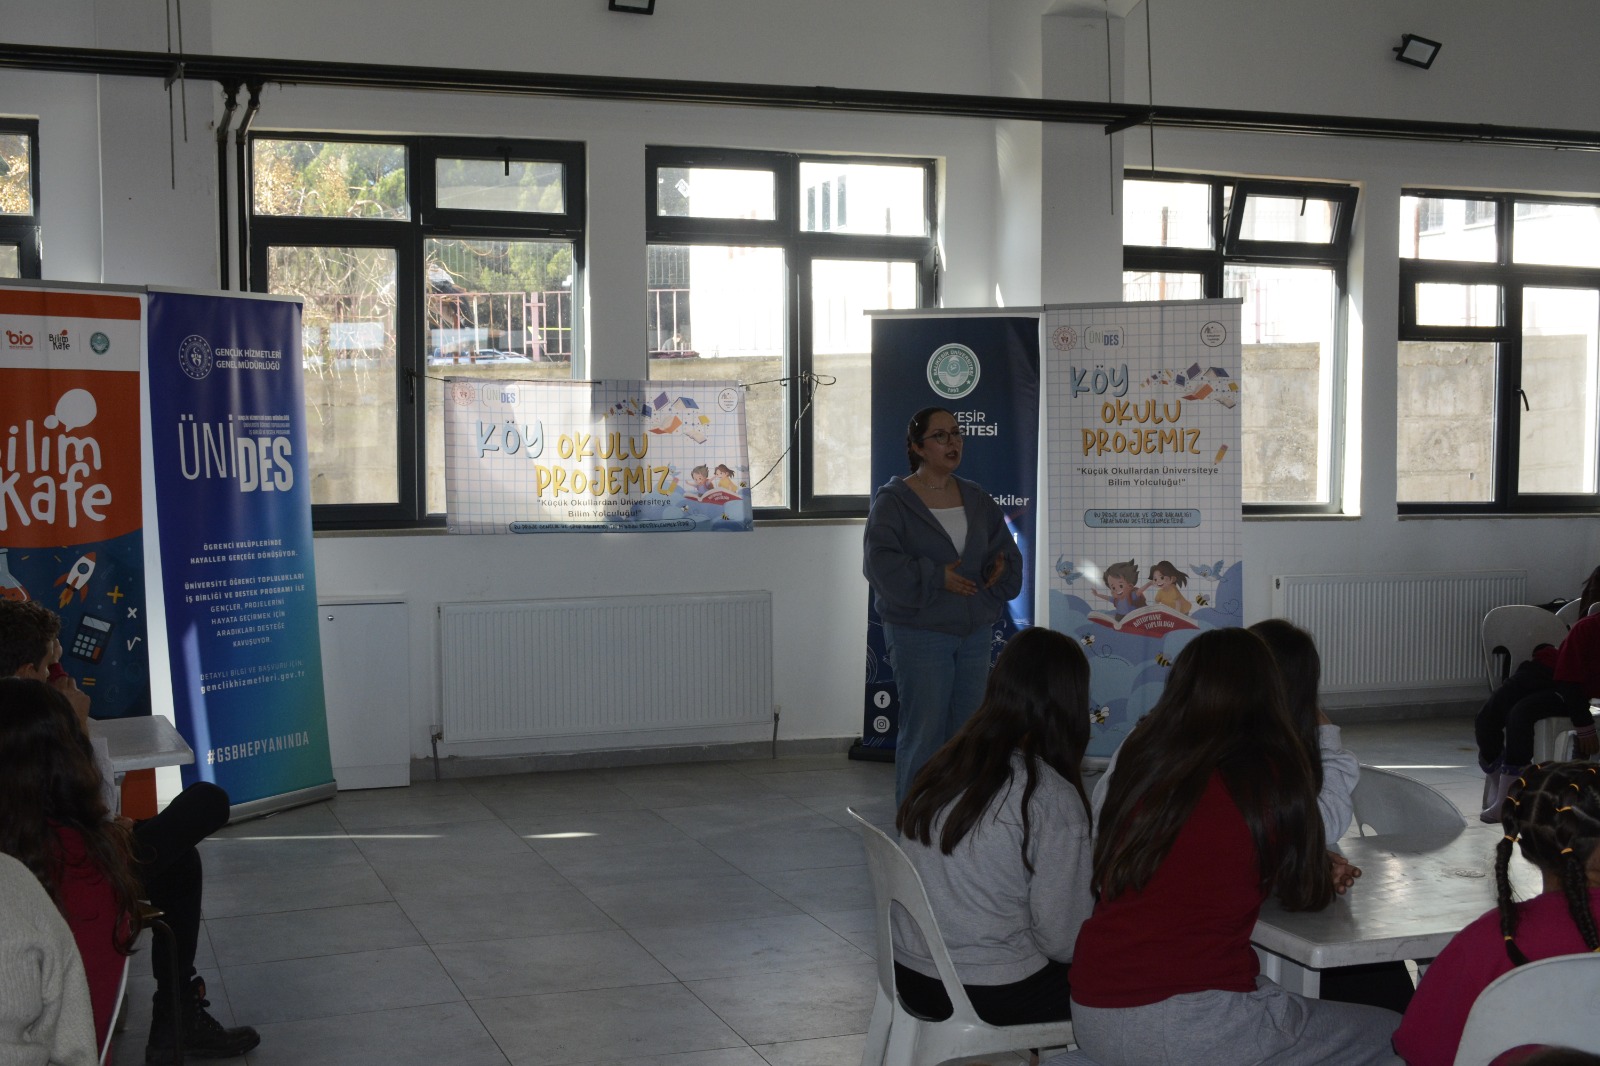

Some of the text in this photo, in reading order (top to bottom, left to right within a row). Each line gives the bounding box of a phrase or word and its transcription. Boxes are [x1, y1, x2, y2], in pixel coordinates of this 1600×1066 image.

[6, 330, 34, 345] bio
[215, 348, 281, 359] GENÇLİK HİZMETLERİ
[216, 360, 280, 371] GENEL MÜDÜRLÜĞÜ
[1070, 363, 1129, 398] KÖY
[953, 409, 986, 423] ESİR
[1101, 399, 1182, 426] OKULU
[0, 414, 102, 475] ilim
[475, 419, 649, 463] KÖY OKULU
[1081, 427, 1201, 457] PROJEMİZ
[1111, 467, 1160, 475] Okullardan
[1162, 466, 1219, 476] Üniversiteye
[534, 464, 670, 498] PROJEMİZ
[1108, 478, 1131, 486] Bilim
[0, 462, 112, 531] Kafe
[570, 499, 618, 507] Okullardan
[620, 498, 671, 507] Üniversiteye
[568, 510, 590, 518] Bilim
[236, 539, 282, 549] KULÜPLERİNDE
[190, 555, 227, 565] HAYALLER
[228, 552, 256, 562] GERÇEĞE
[184, 573, 305, 590] ÜNİVERSİTE ÖĞRENCİ TOPLULUKLARI
[185, 595, 193, 604] İŞ
[195, 591, 222, 602] BİRLİĞİ
[235, 589, 258, 598] DESTEK
[260, 586, 293, 596] PROGRAMI
[211, 616, 238, 625] HAYATA
[239, 612, 271, 622] GEÇİRMEK
[216, 627, 256, 637] ARADIKLARI
[200, 672, 229, 681] DETAYLI
[230, 669, 247, 677] BİLGİ
[248, 666, 257, 674] VE
[258, 662, 288, 673] BAŞVURU
[200, 670, 305, 695] genclikhizmetleri.gov.tr
[207, 731, 310, 765] #GSBHEPYANINDA
